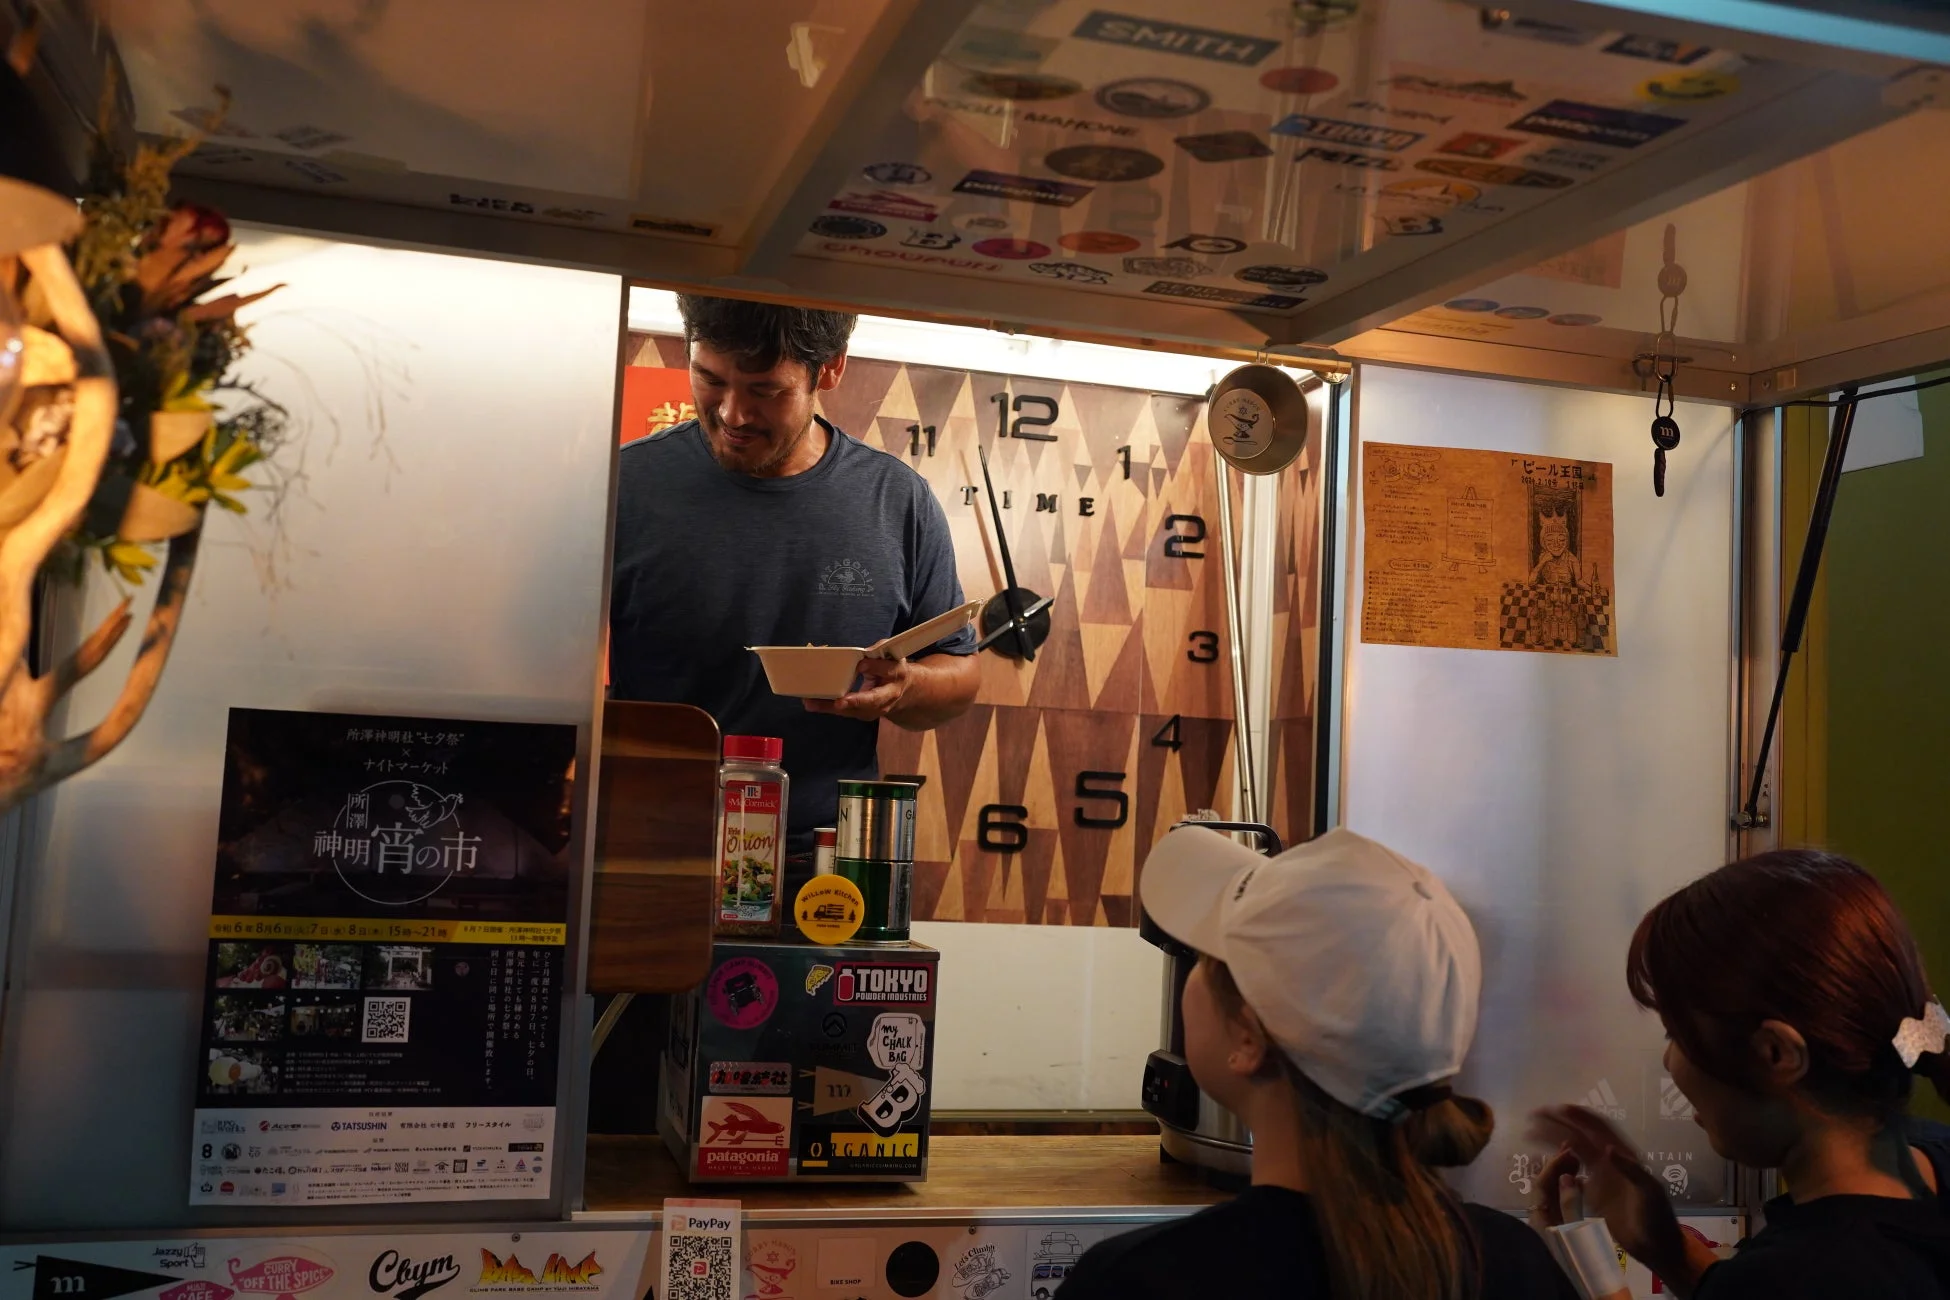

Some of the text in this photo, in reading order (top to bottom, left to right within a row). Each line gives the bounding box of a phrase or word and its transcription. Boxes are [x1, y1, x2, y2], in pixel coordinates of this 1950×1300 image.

[1096, 20, 1256, 60] SMITH
[991, 392, 1059, 441] 12
[906, 425, 936, 457] 11
[1116, 445, 1132, 480] 1
[960, 485, 1094, 516] TIME
[1164, 514, 1207, 558] 2
[1188, 630, 1220, 663] 3
[1151, 713, 1182, 754] 4
[364, 758, 449, 776] ナイトマーケット
[1073, 771, 1128, 829] 5
[978, 804, 1028, 853] 6
[313, 822, 484, 877] 神明宵の市
[727, 834, 774, 853] Onion
[857, 968, 928, 993] TOKYO
[855, 991, 927, 1001] POWDER INDUSTRIES
[883, 1036, 912, 1051] CHALK
[888, 1050, 907, 1063] BAG
[342, 1122, 388, 1130] TATSUSHIN
[465, 1121, 512, 1129] フリースタイル
[706, 1150, 780, 1165] patagonia
[810, 1142, 913, 1158] ORGANIC
[1647, 1151, 1693, 1161] NTAIN
[689, 1217, 732, 1231] PayPay
[153, 1247, 184, 1258] Jazzy
[159, 1258, 189, 1269] Sport
[263, 1259, 299, 1277] CURRY
[50, 1276, 86, 1294] m
[269, 1273, 294, 1292] THE
